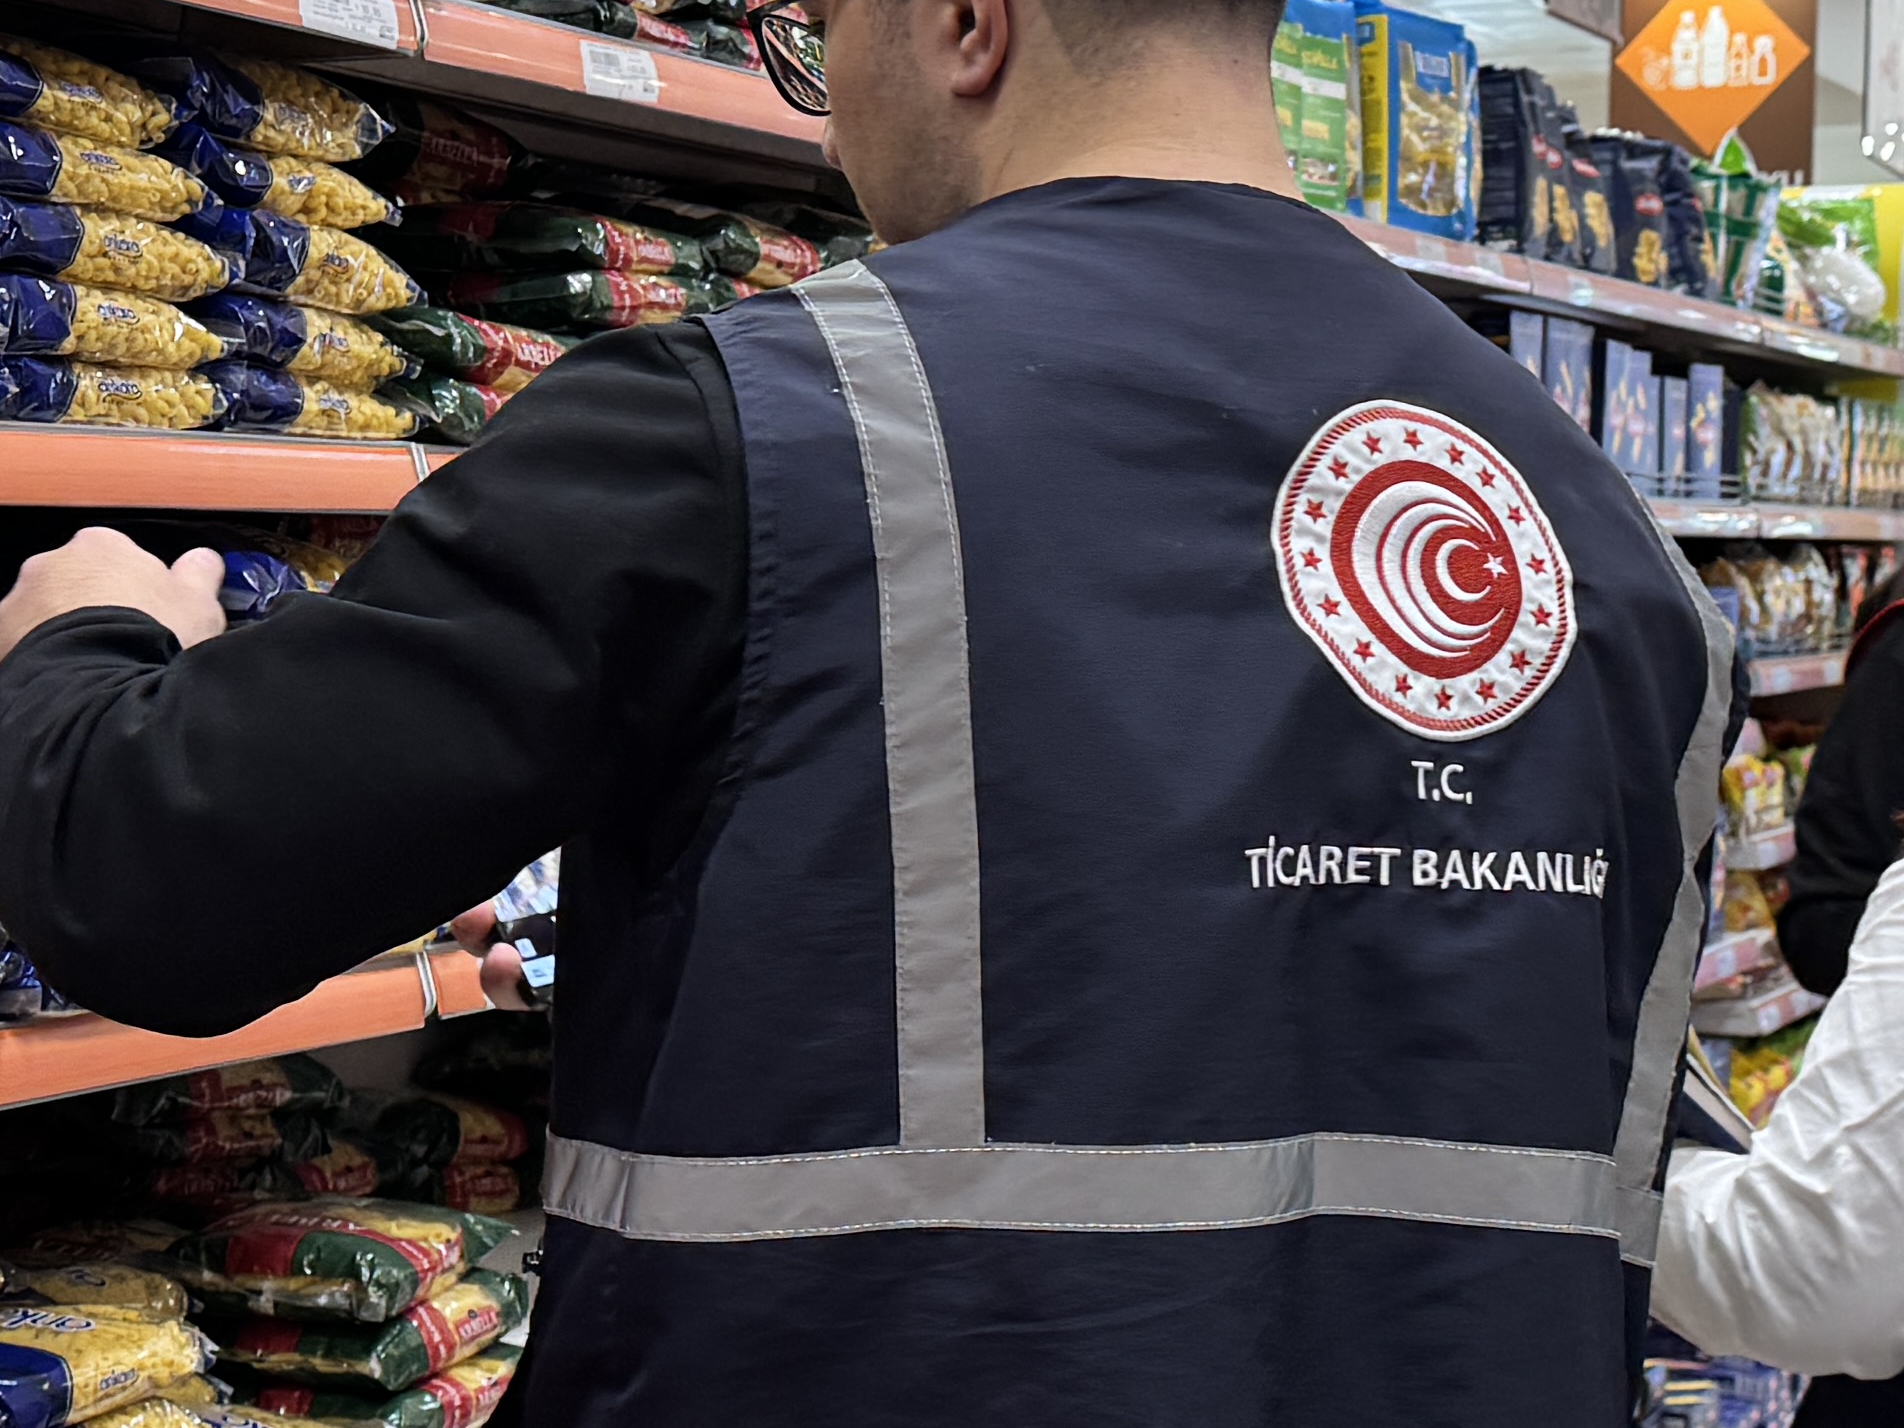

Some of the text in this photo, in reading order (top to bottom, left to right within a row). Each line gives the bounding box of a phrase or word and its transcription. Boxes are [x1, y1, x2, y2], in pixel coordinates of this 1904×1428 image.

[99, 381, 141, 400] ankara
[1411, 760, 1473, 804] T.C.
[1245, 835, 1401, 890] TİCARET
